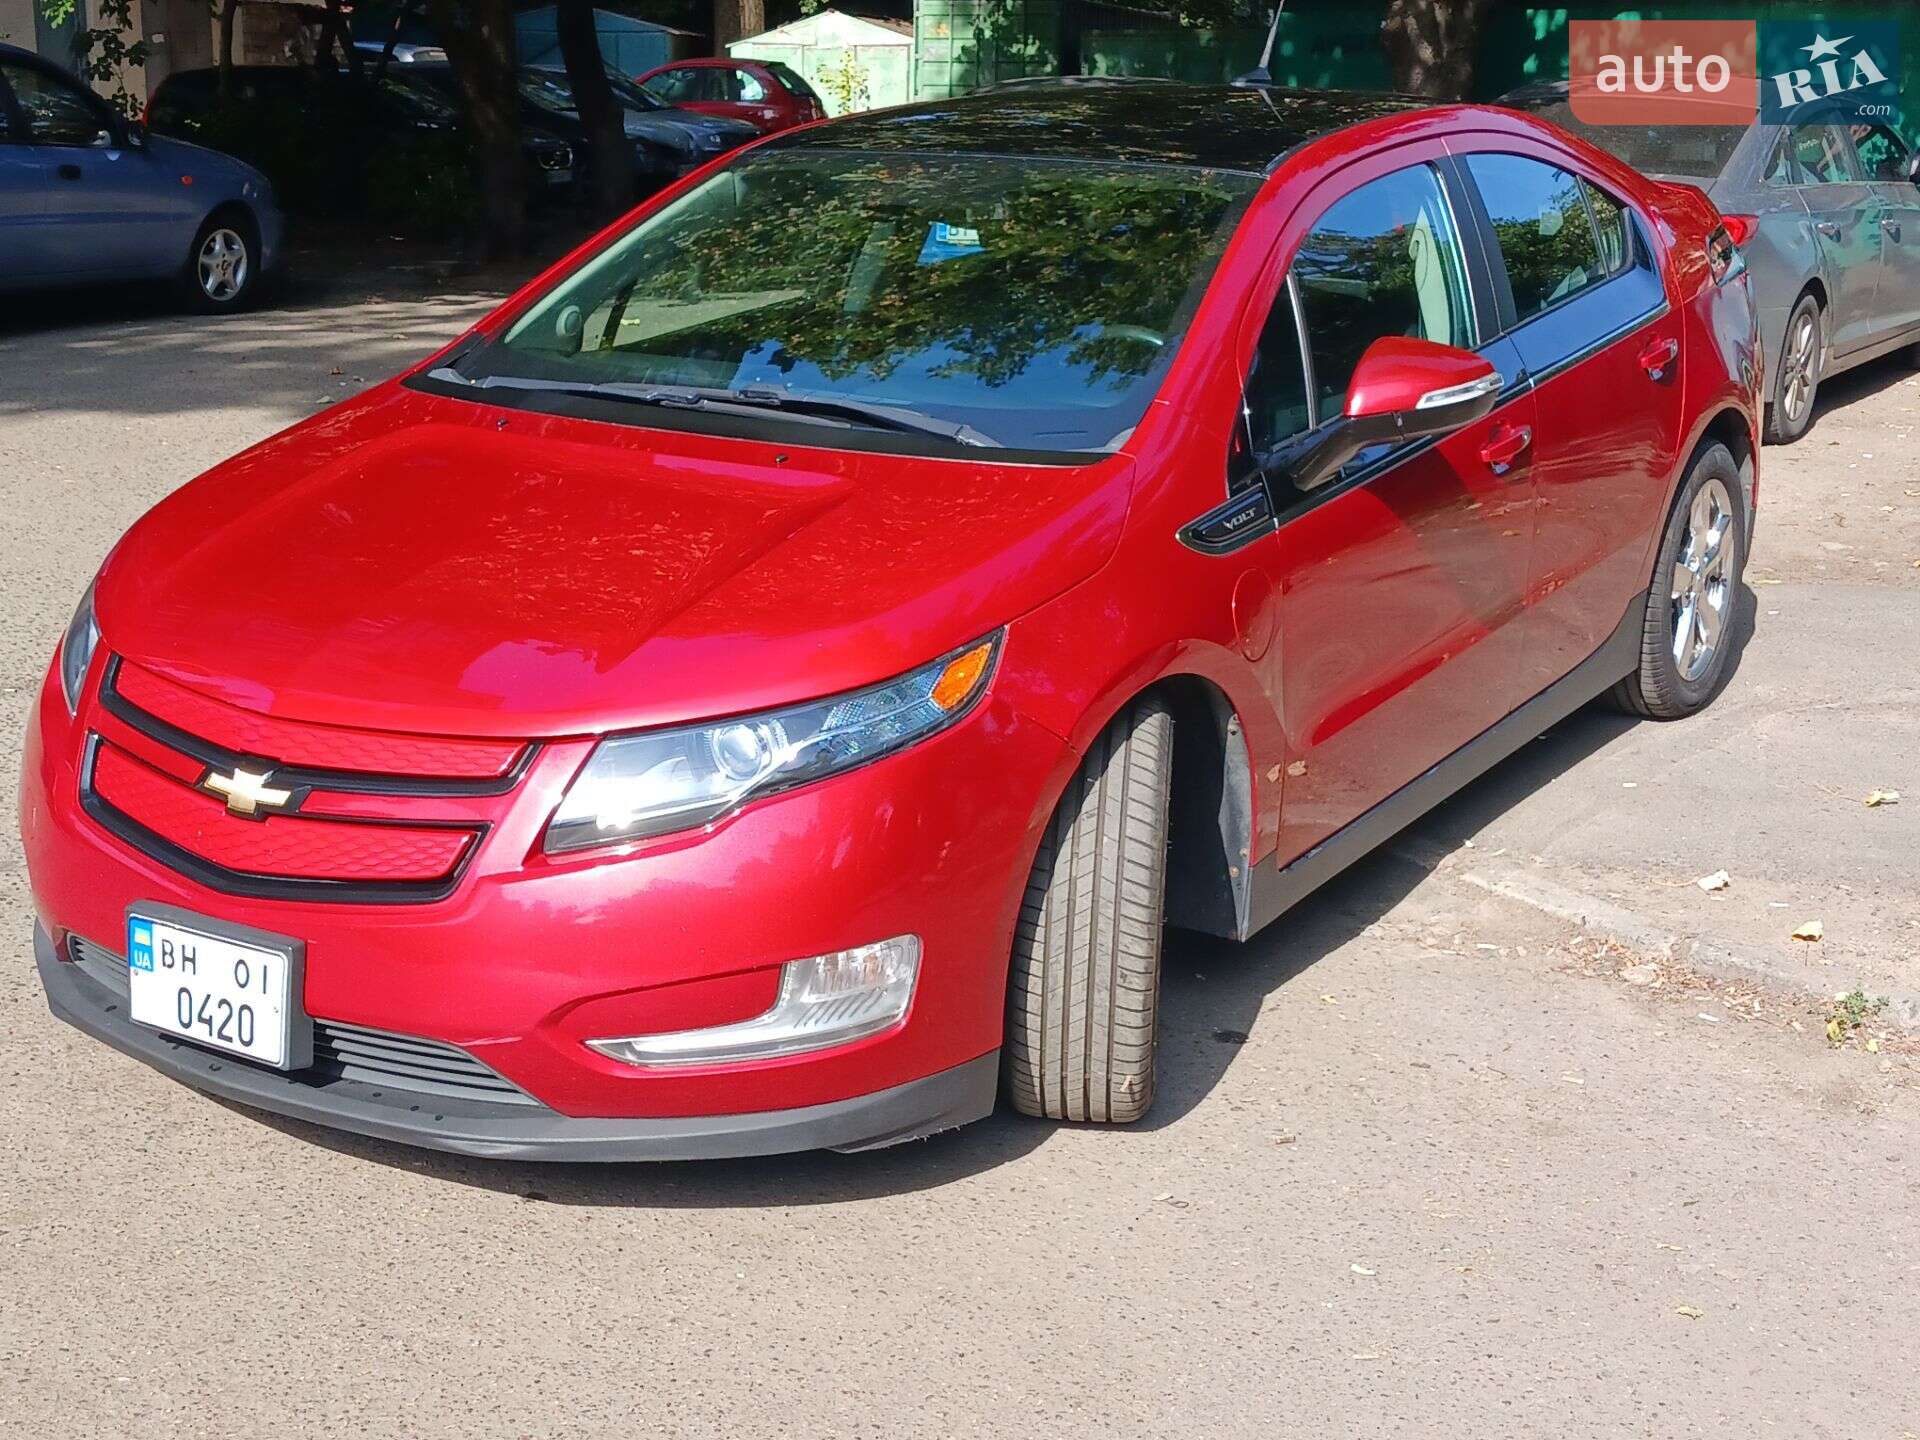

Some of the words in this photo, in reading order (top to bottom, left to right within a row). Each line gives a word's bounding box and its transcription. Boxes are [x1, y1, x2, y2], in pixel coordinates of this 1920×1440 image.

[1222, 507, 1257, 531] VOLT
[134, 949, 152, 969] UA
[161, 938, 197, 976] BH
[177, 986, 254, 1048] 0420
